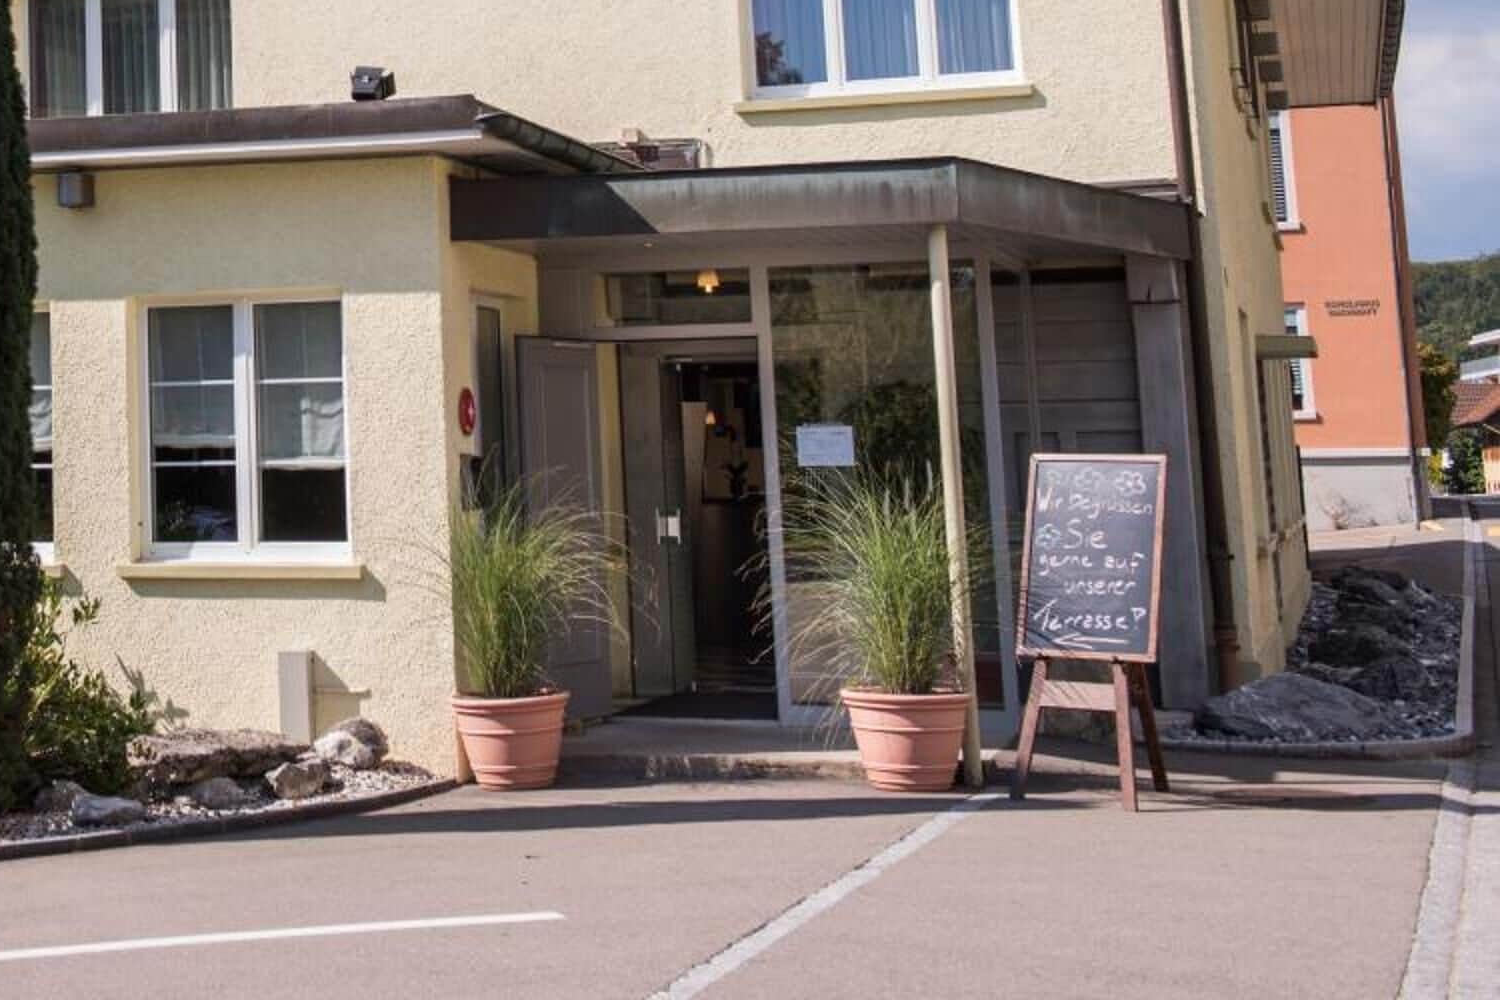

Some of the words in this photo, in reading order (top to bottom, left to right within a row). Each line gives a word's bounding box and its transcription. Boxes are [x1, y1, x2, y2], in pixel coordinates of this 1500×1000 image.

[1036, 487, 1063, 512] Wir
[1062, 518, 1108, 549] Sie
[1038, 554, 1093, 576] gerne
[1104, 552, 1145, 575] auf
[1063, 580, 1136, 595] unserer
